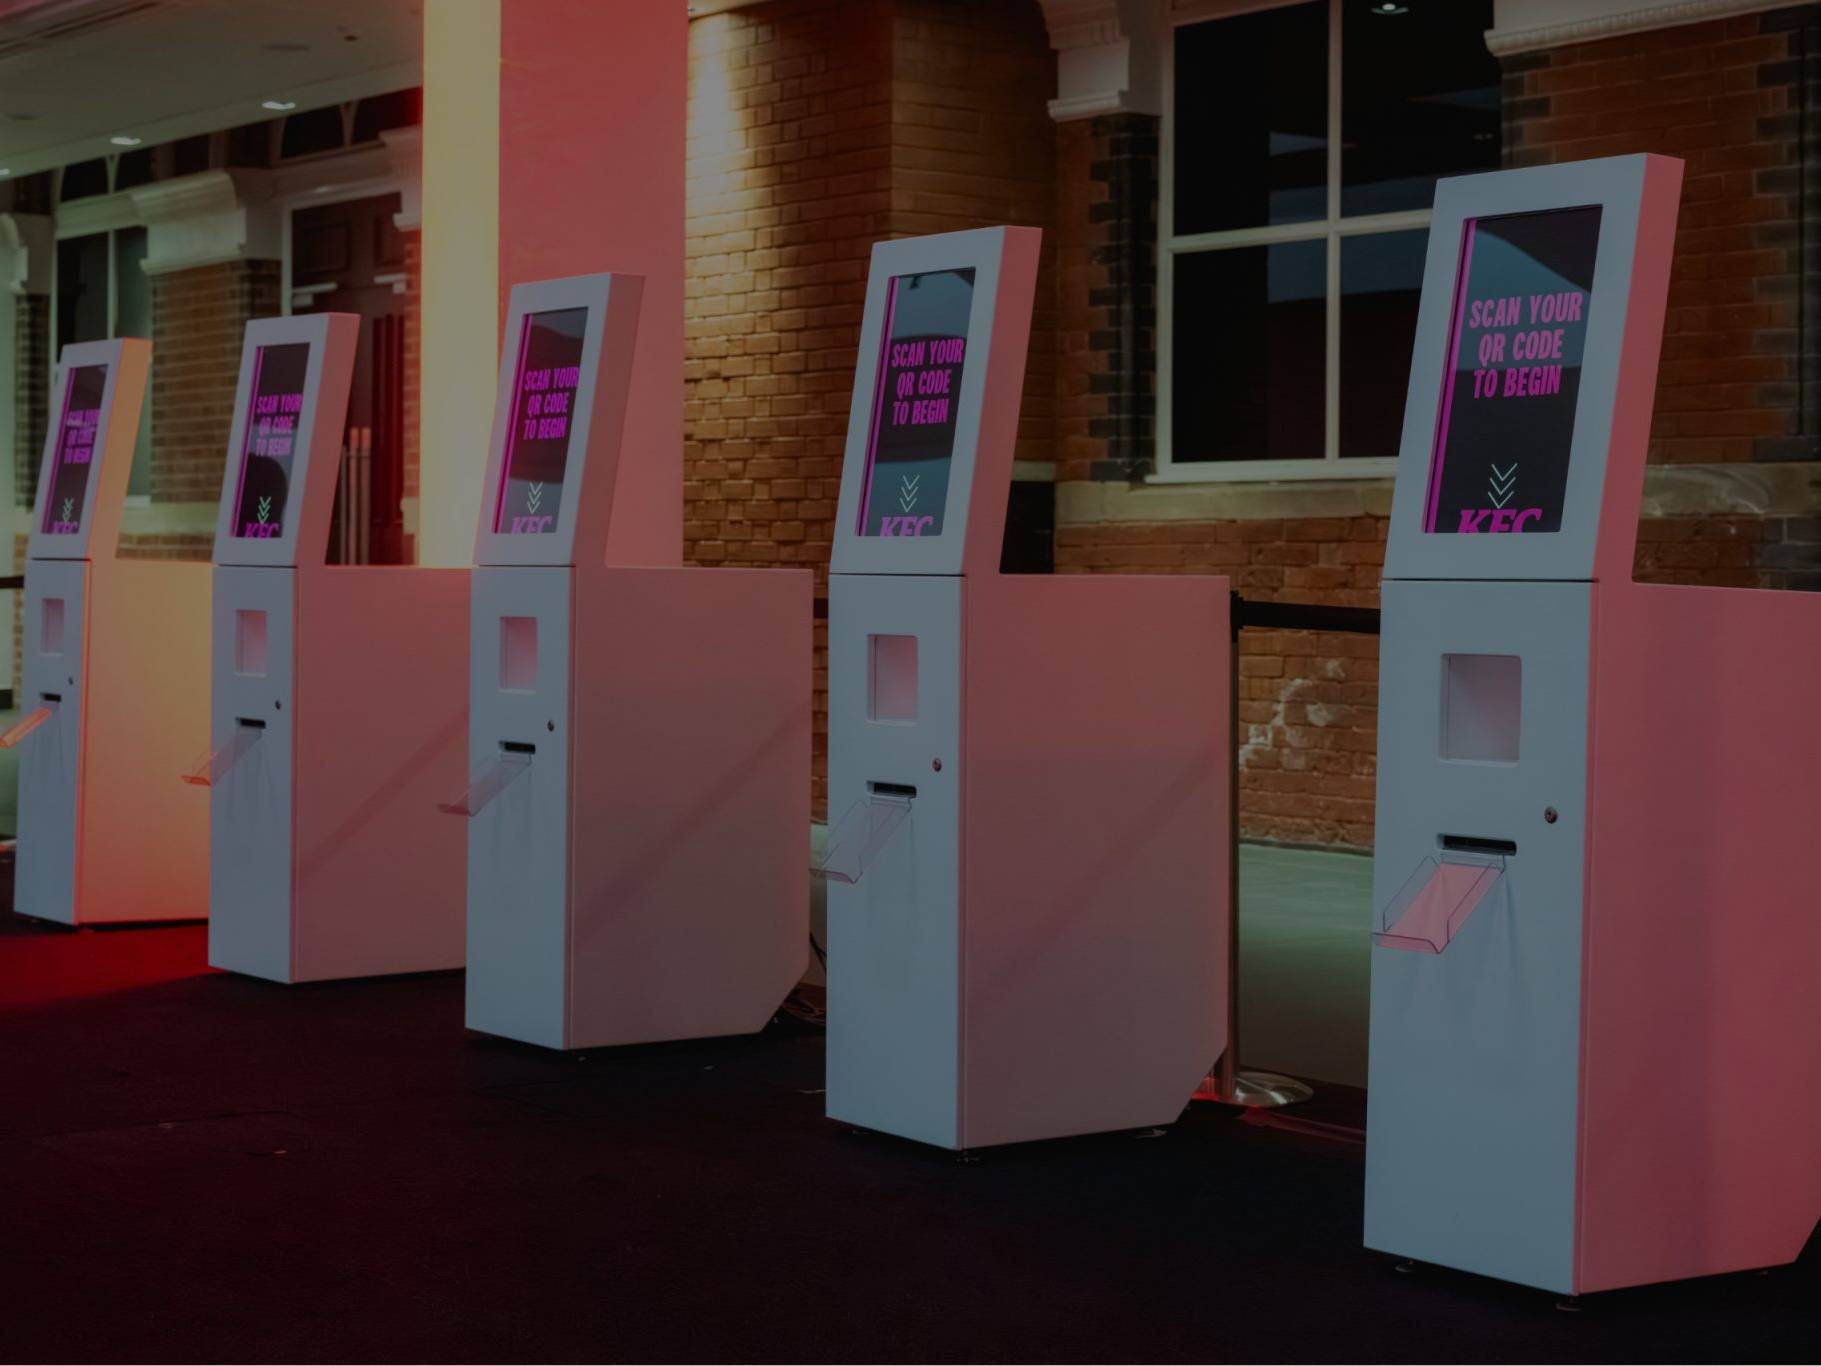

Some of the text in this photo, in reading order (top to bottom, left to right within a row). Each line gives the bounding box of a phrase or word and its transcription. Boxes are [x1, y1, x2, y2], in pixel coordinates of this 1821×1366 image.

[1469, 292, 1582, 328] SCAN YOUR
[893, 338, 963, 367] SCAN YOUR
[1479, 329, 1564, 366] QR CODE
[525, 367, 579, 390] SCAN YOUR
[898, 369, 951, 398] QR CODE
[1474, 365, 1561, 398] TO BEGIN
[528, 392, 569, 417] QR CODE
[893, 399, 948, 425] TO BEGIN
[524, 417, 567, 439] TO BEGIN
[881, 516, 933, 536] KFC
[1458, 508, 1542, 533] KFC
